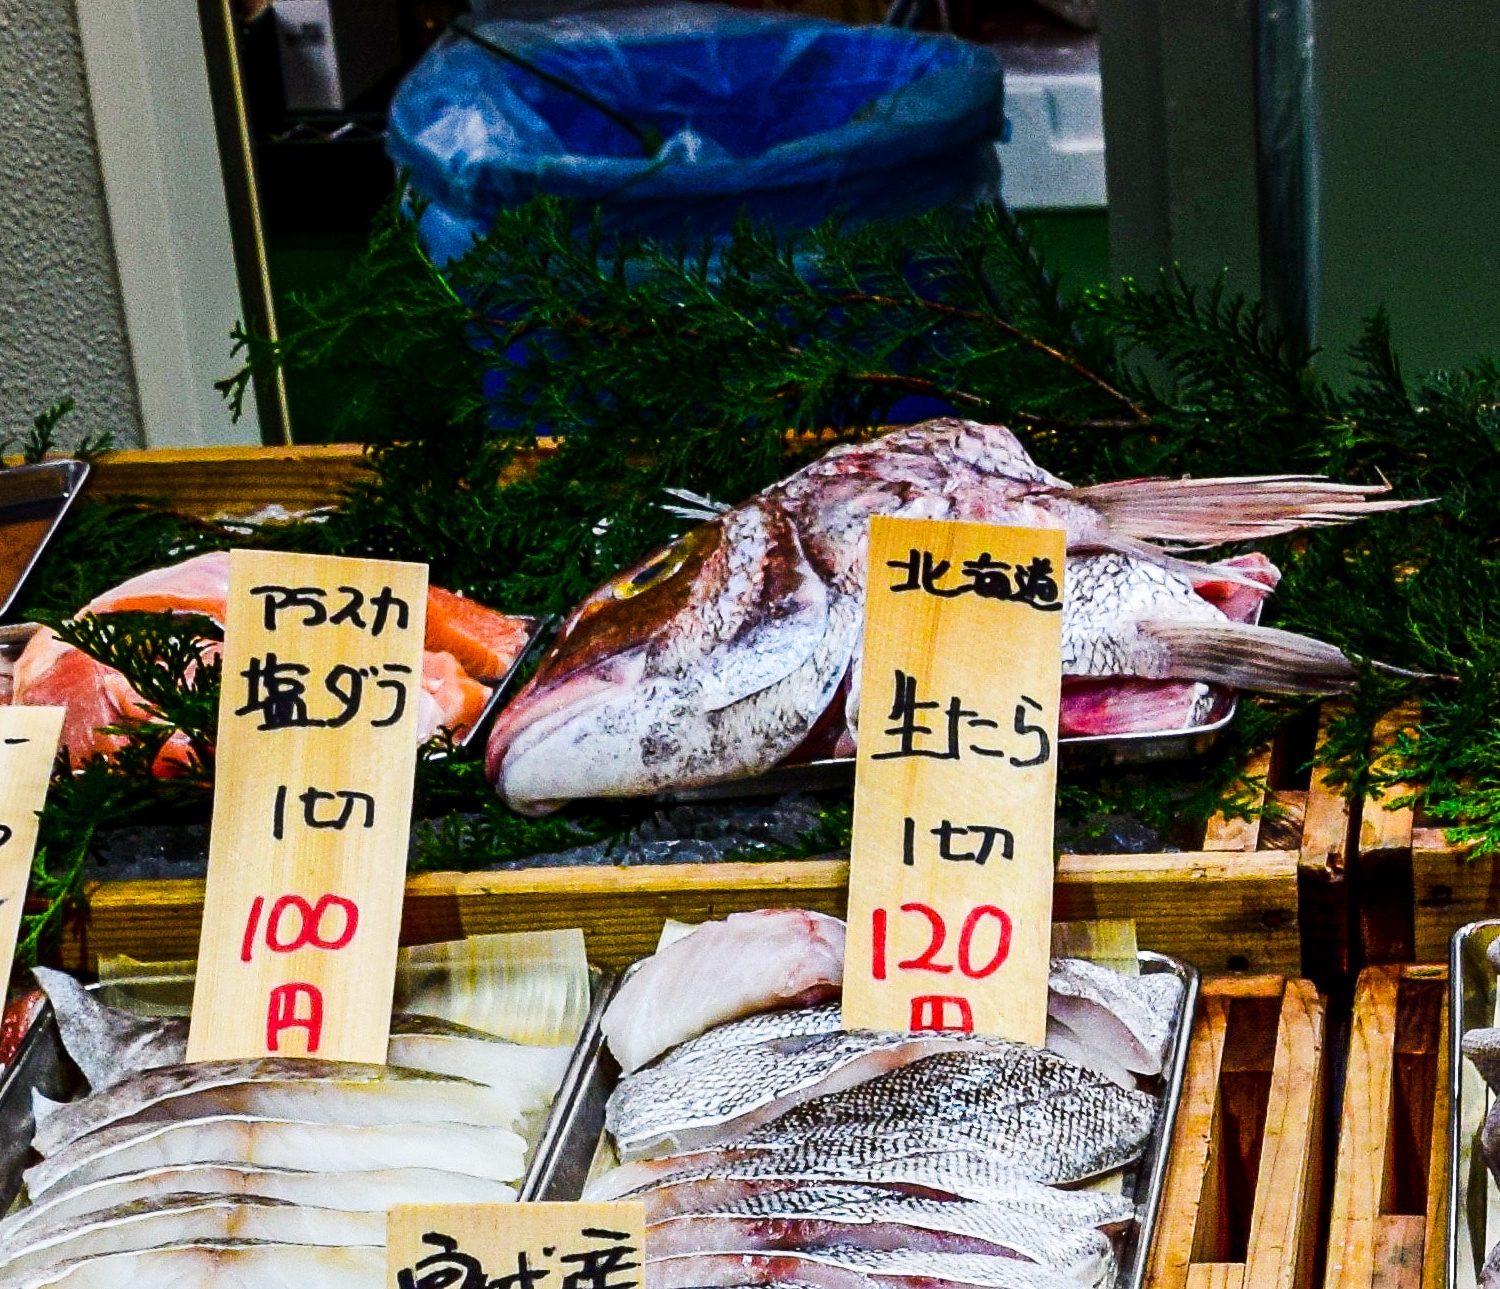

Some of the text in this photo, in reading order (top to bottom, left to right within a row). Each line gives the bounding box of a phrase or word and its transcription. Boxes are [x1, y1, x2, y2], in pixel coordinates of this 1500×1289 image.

[250, 586, 409, 635] アラスカ
[887, 548, 1064, 612] 北海道
[235, 652, 411, 731] 塩ダラ
[870, 668, 1051, 767] 生たら
[273, 786, 375, 840] 1切
[903, 817, 1014, 865] 1切
[241, 893, 359, 963] 100
[872, 902, 1013, 980] 120
[266, 982, 324, 1053] 円
